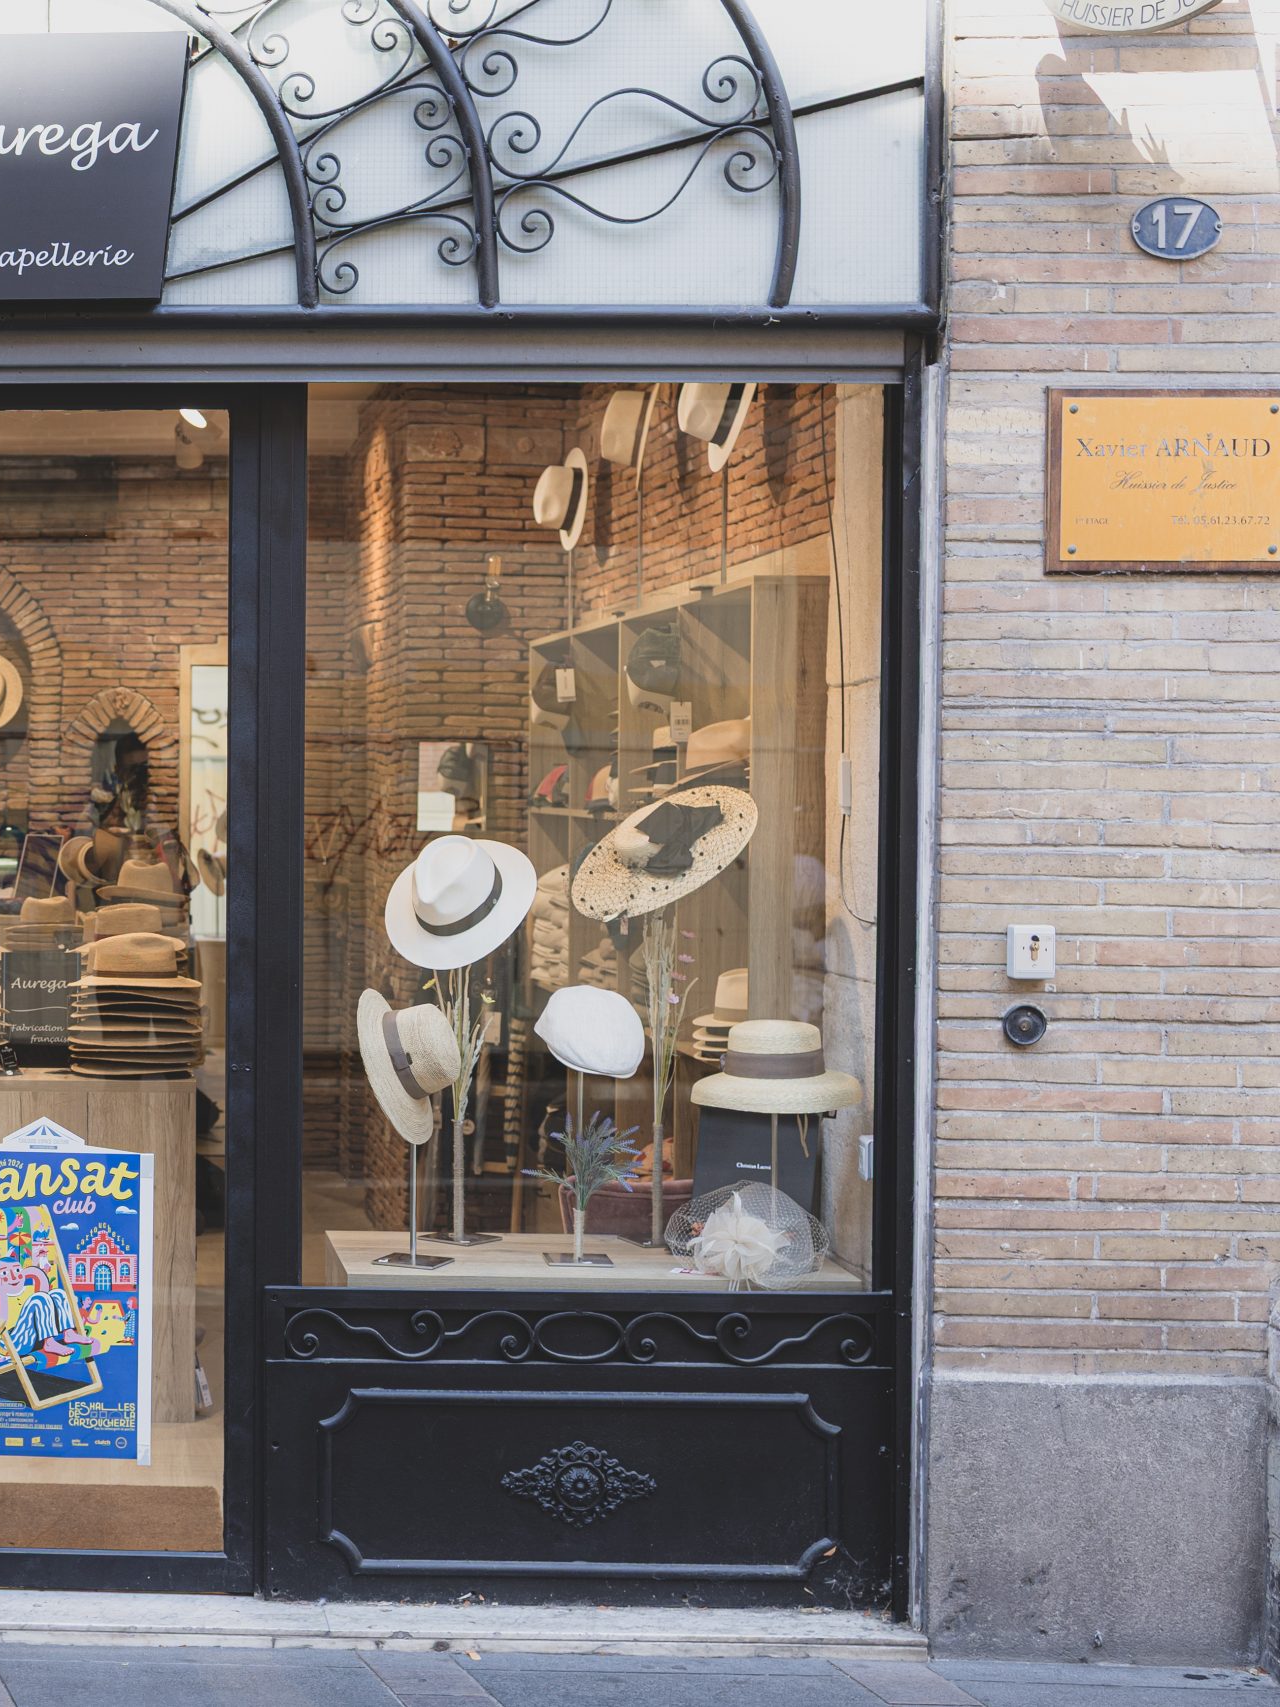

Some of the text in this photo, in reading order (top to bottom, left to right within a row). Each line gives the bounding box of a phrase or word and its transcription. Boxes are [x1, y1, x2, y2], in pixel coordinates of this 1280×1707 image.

[1060, 0, 1134, 26] HUISSIER
[1140, 2, 1165, 24] DE
[1151, 204, 1205, 250] 17
[1076, 437, 1271, 457] Xavier ARNAUD
[1109, 469, 1238, 494] Huissier de Justice
[1193, 515, 1271, 526] 05.61.23.67.72
[11, 977, 68, 993] Aurega
[11, 1023, 64, 1033] Fabrication
[52, 1195, 96, 1215] club
[68, 1418, 136, 1429] CARTOUCHERIE
